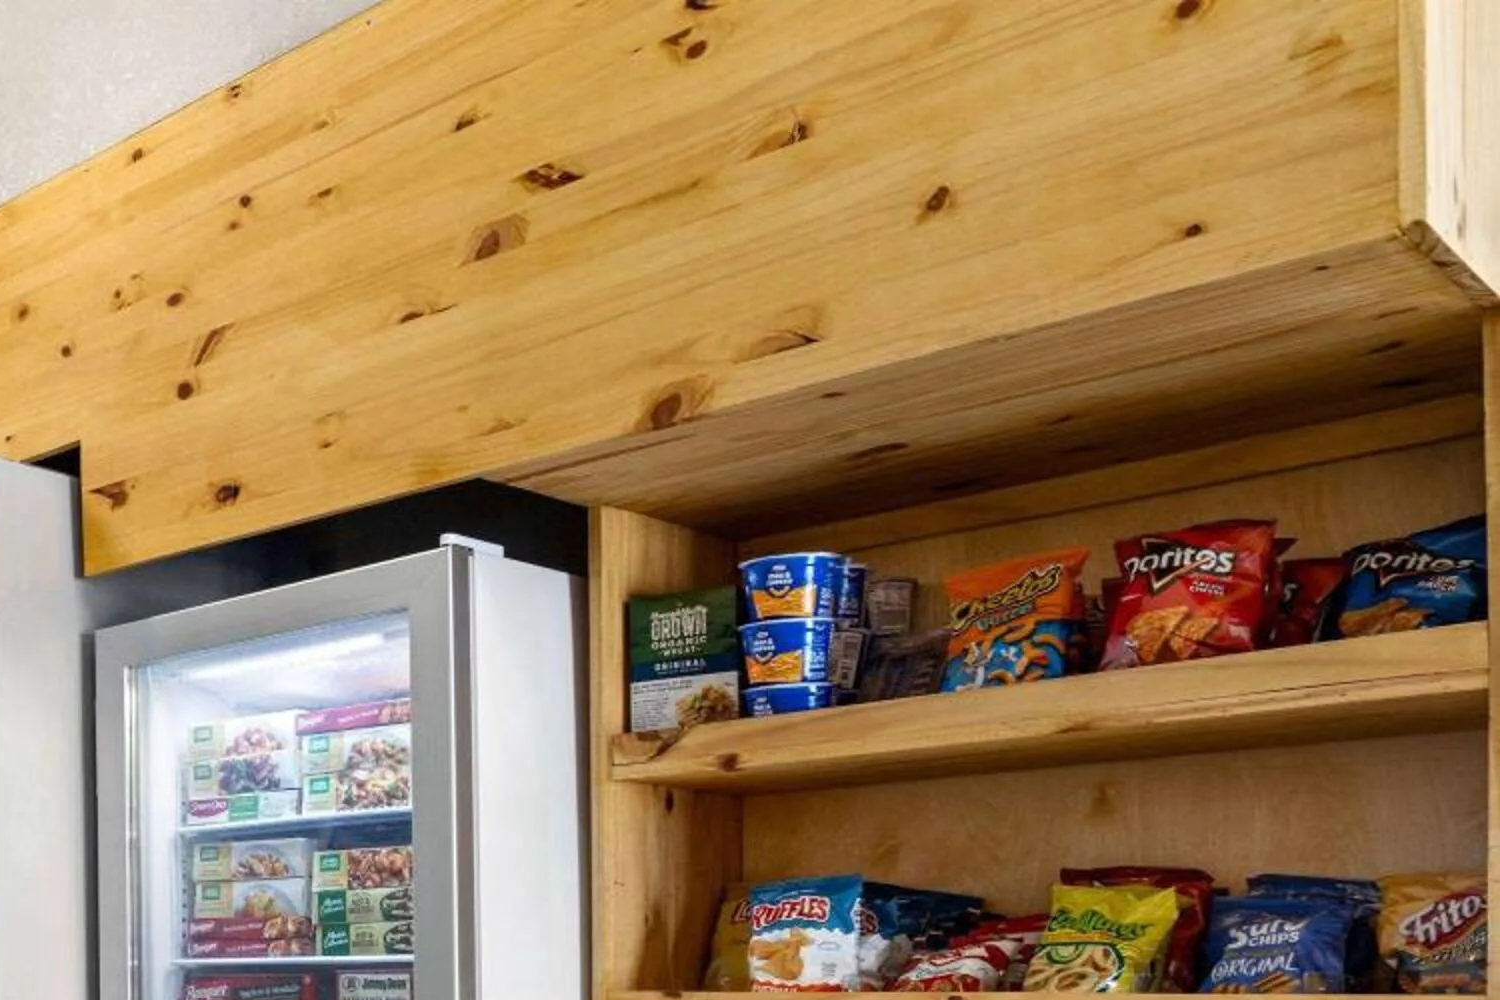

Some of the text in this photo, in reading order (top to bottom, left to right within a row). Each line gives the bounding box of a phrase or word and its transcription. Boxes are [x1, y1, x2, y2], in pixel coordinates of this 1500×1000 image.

[751, 896, 829, 930] RUFFLES
[1399, 895, 1488, 944] Frito
[1248, 930, 1300, 947] CHIPS
